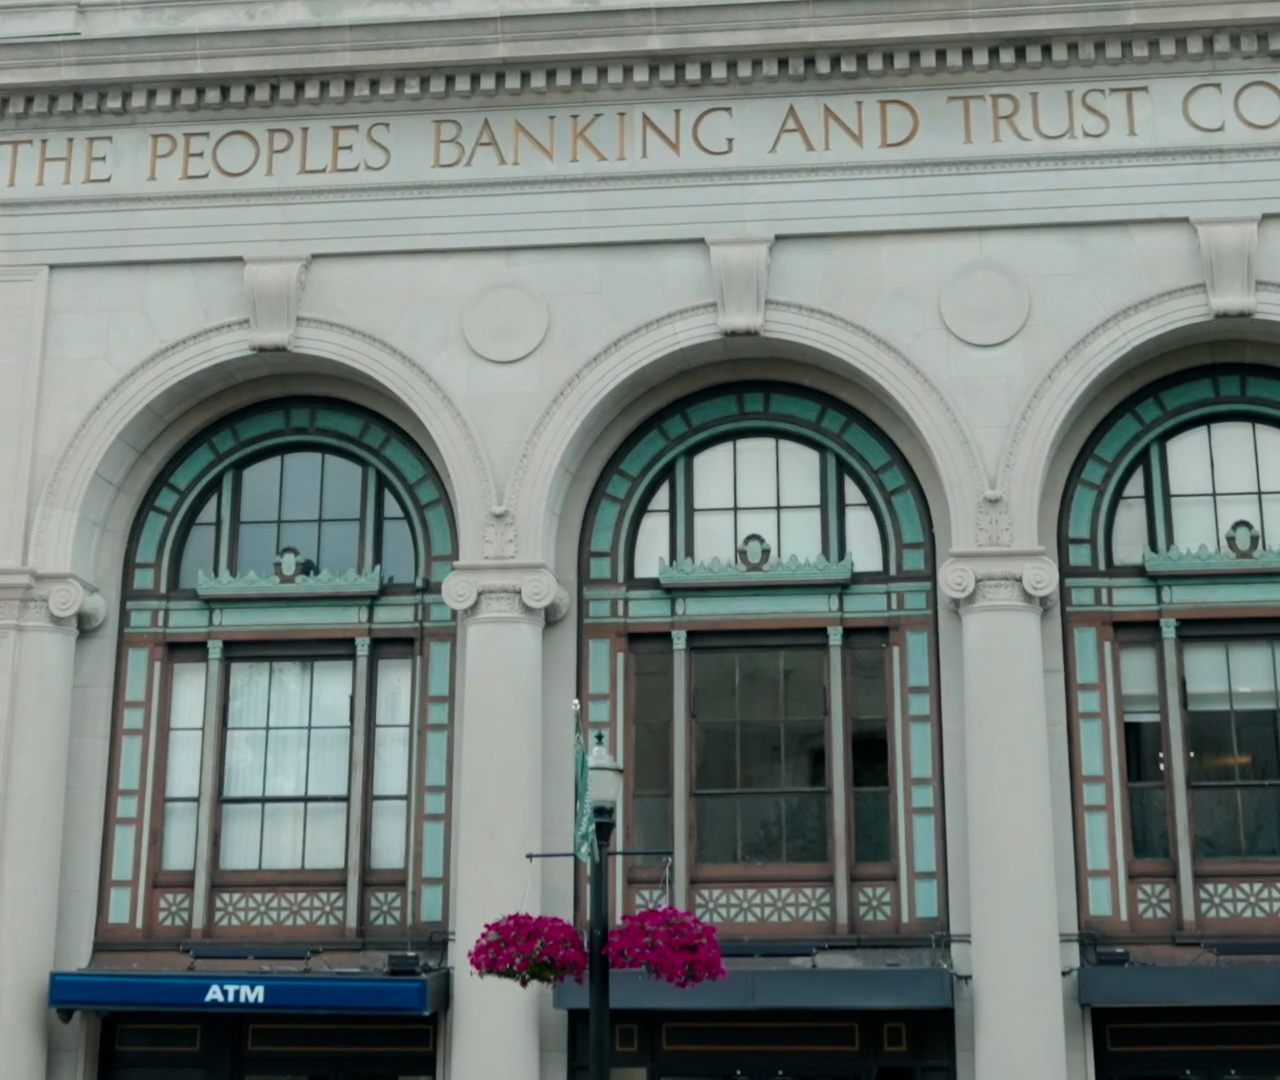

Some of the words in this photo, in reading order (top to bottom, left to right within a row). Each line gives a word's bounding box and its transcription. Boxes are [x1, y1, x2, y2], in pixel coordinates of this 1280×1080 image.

[146, 122, 392, 182] PEOPLES
[431, 107, 735, 169] BANKING
[768, 99, 921, 154] AND
[947, 86, 1149, 145] TRUST
[204, 984, 265, 1003] ATM
